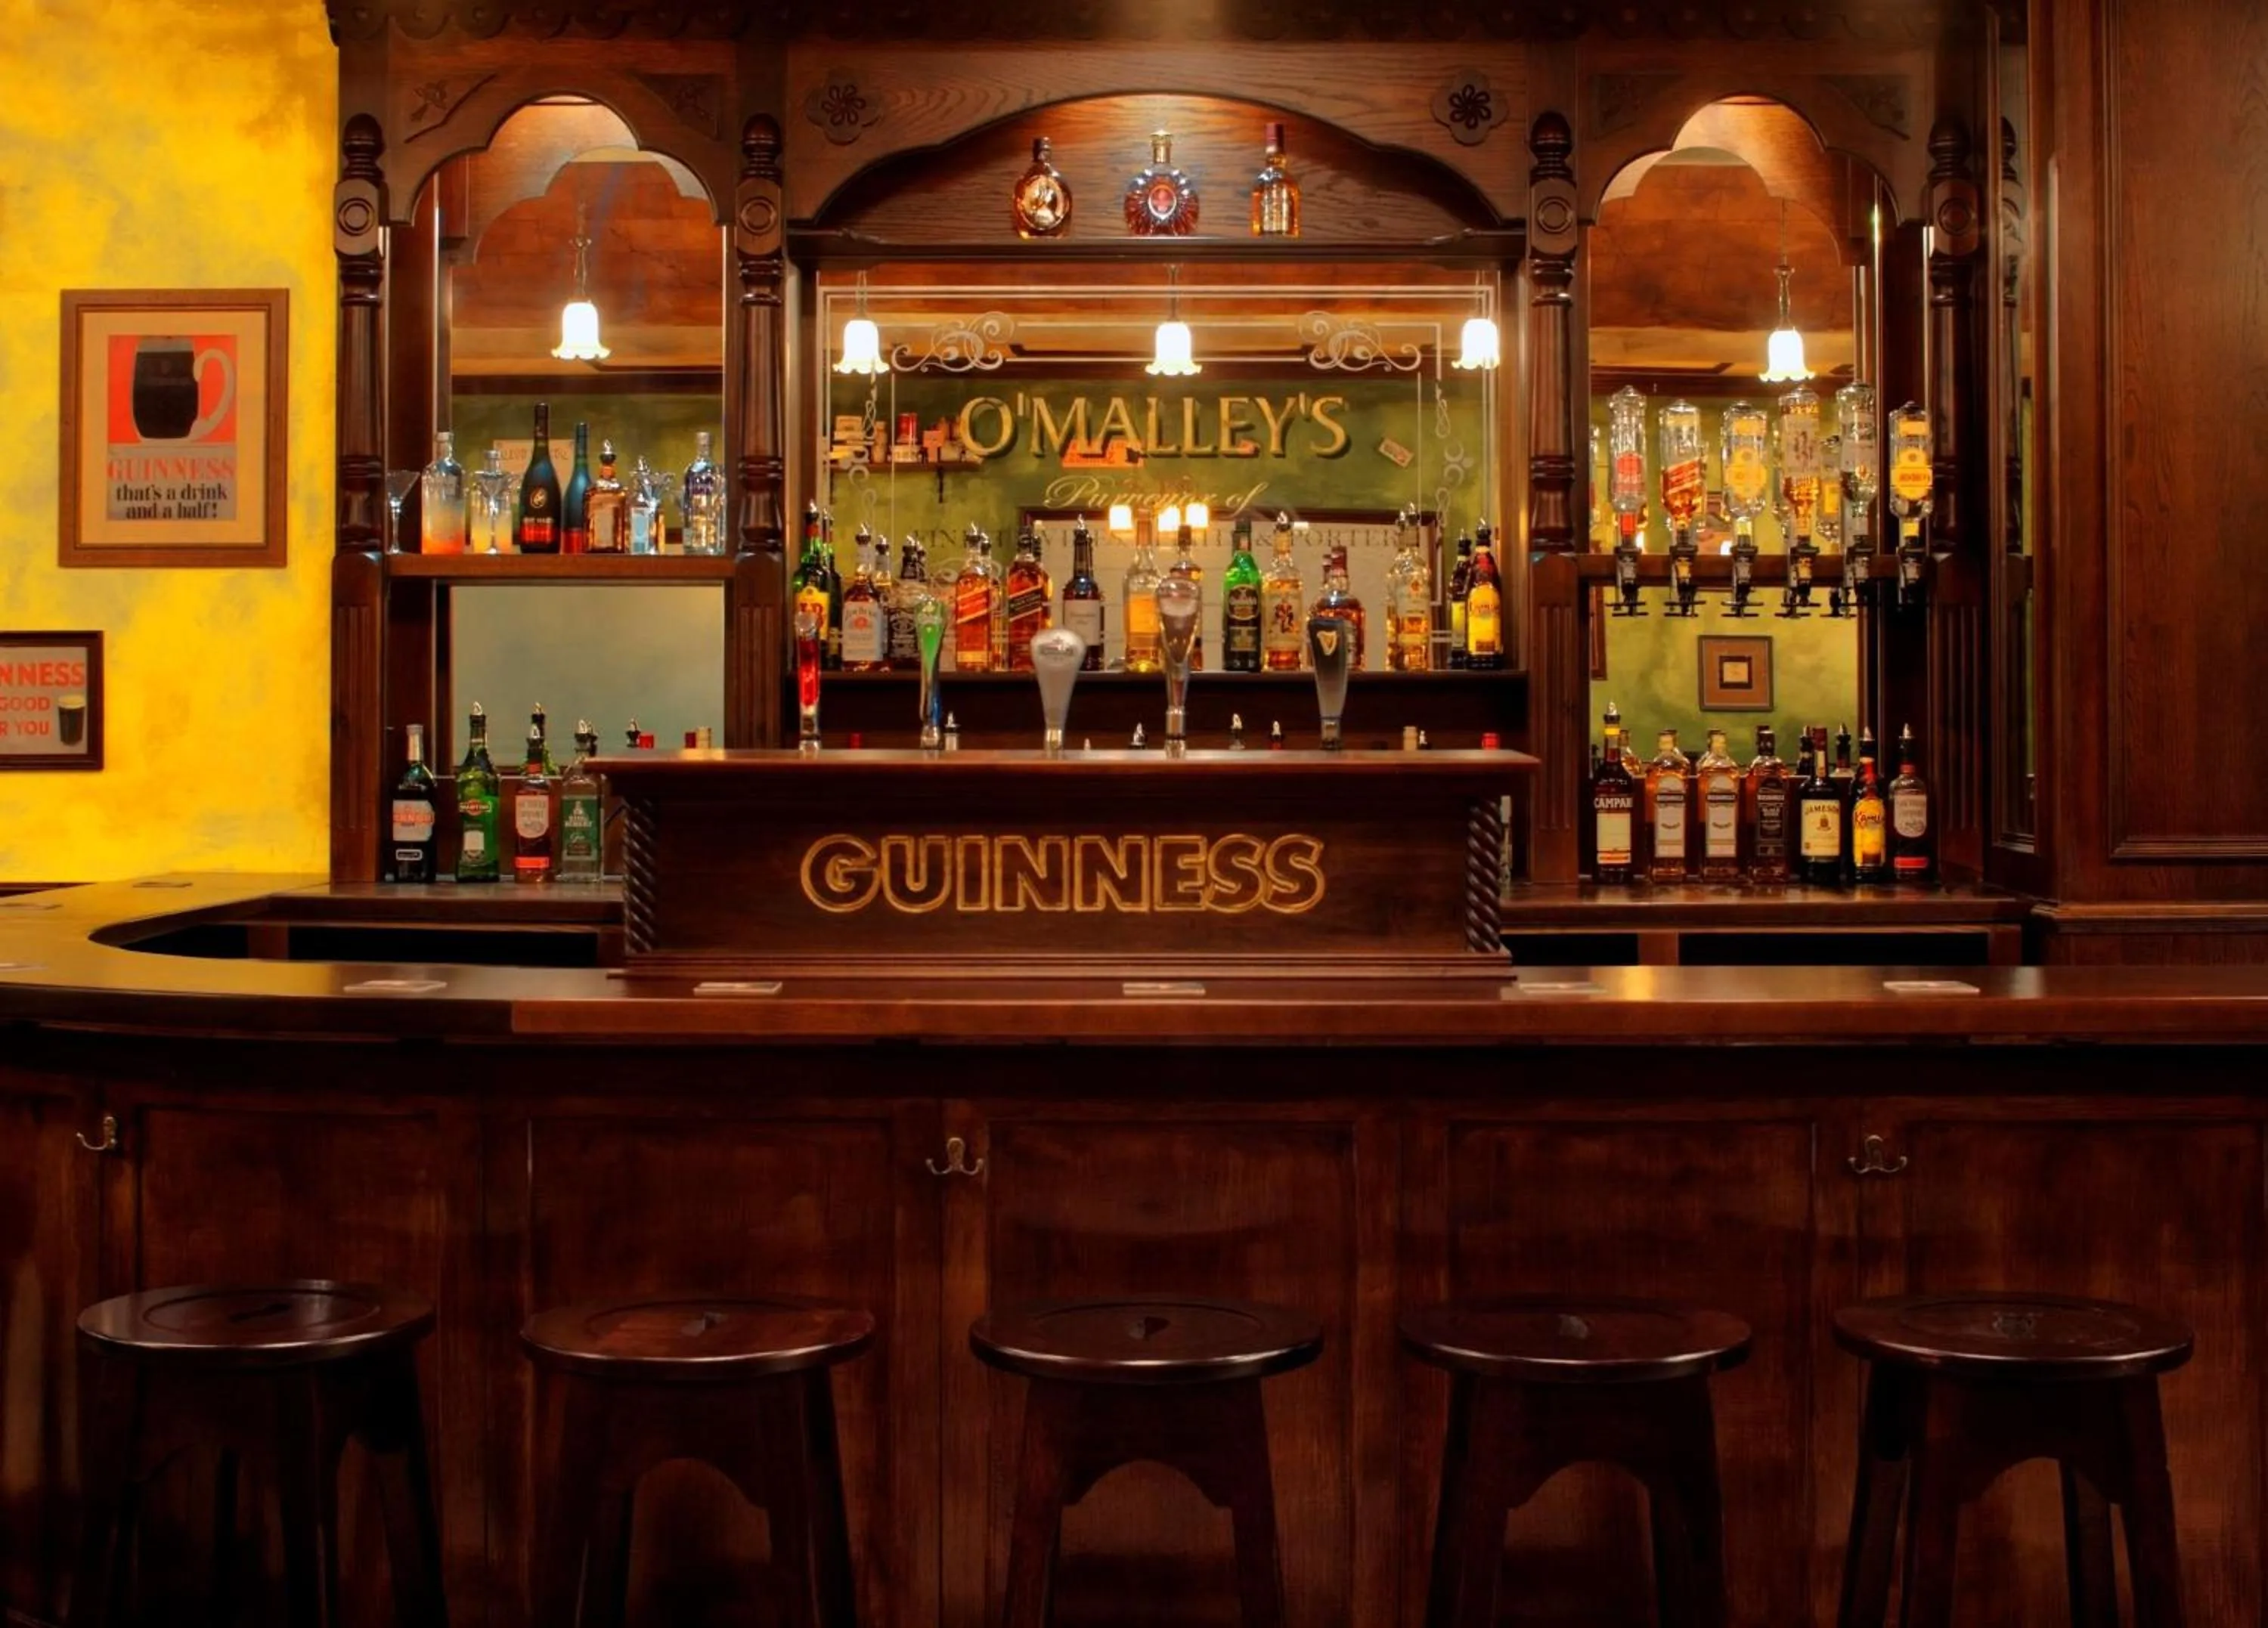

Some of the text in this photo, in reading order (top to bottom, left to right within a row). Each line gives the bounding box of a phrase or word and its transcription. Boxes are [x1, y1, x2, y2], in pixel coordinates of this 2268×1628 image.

[960, 392, 1349, 458] O'MALLEY'S
[107, 458, 234, 480] GUINNESS
[116, 483, 228, 502] that's a drink
[1225, 482, 1268, 516] of
[125, 503, 157, 519] and
[163, 506, 172, 519] a
[15, 720, 50, 736] YOU
[801, 834, 1325, 914] GUINNESS
